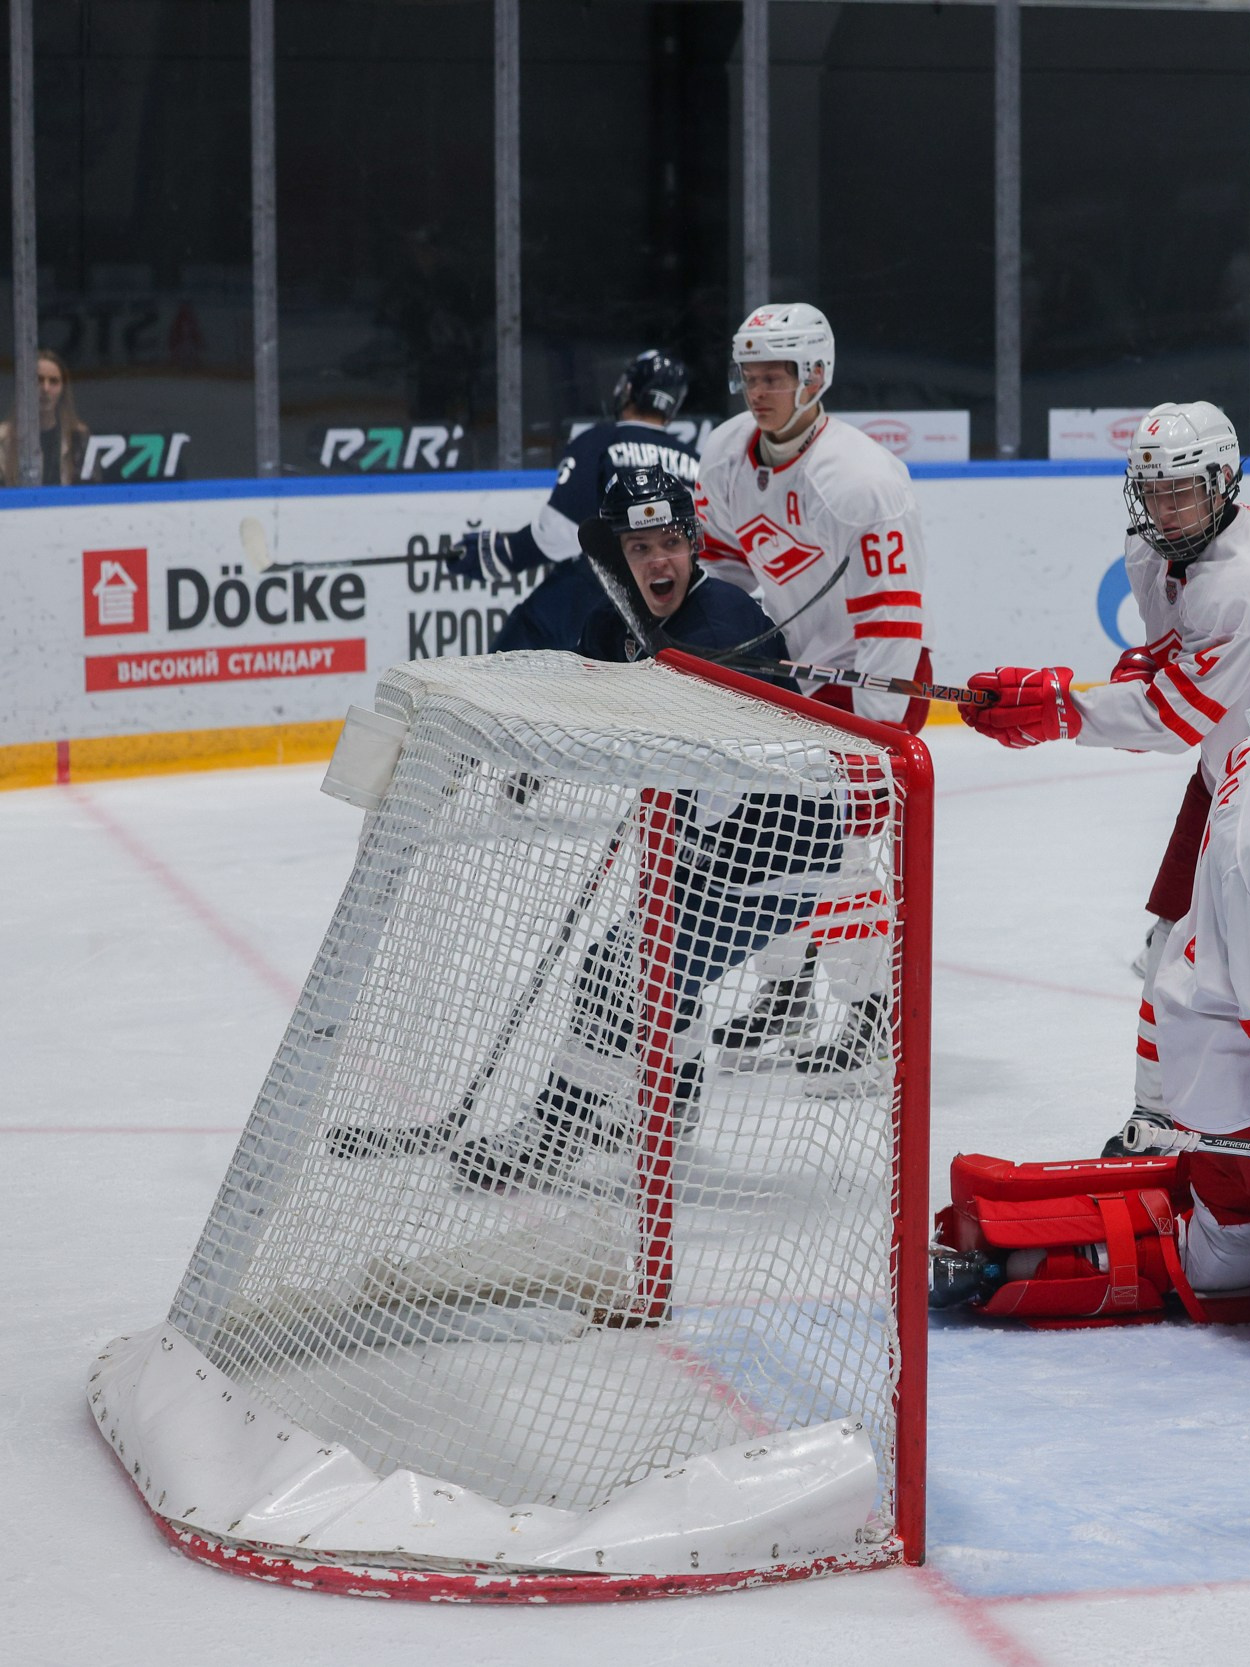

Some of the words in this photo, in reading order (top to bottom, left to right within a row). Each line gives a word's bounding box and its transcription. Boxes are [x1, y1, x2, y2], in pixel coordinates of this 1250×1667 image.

[1147, 419, 1160, 435] 4
[1219, 443, 1236, 452] CCM
[786, 490, 801, 526] A
[861, 531, 907, 577] 62
[166, 565, 366, 632] Döcke
[117, 650, 219, 683] ВЫСОКИЙ
[227, 647, 335, 677] СТАНДАРТ
[779, 659, 892, 692] TRUE
[922, 683, 988, 706] HZRDU
